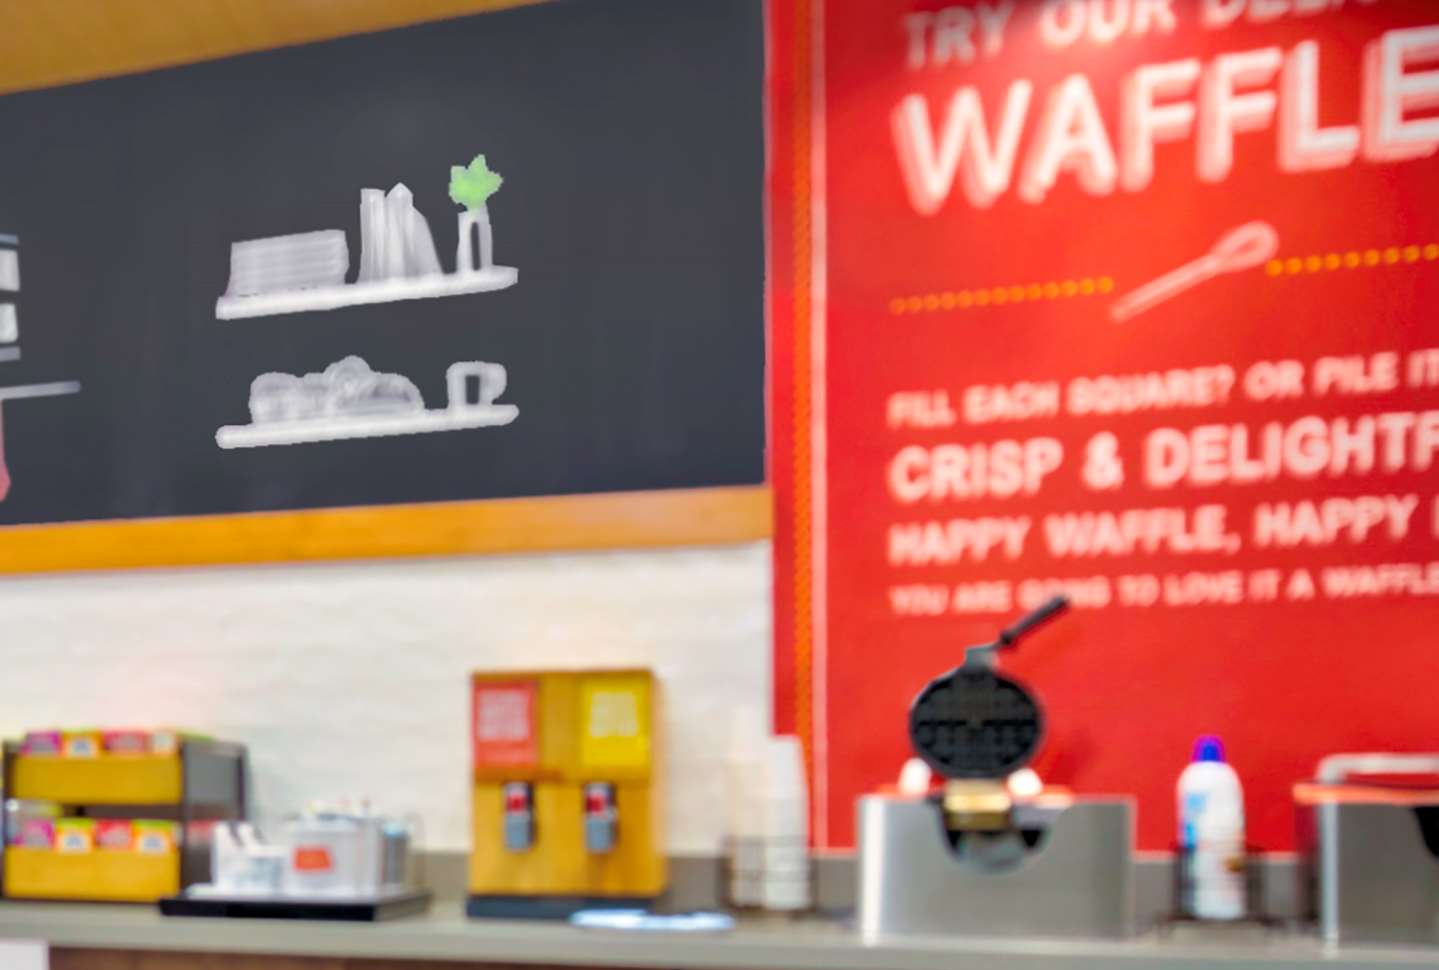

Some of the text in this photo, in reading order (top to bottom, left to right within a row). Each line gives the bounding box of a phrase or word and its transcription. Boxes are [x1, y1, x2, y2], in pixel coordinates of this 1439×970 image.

[904, 0, 1014, 68] TRY
[1040, 0, 1177, 46] OUR
[891, 26, 1439, 214] WAFFLE
[887, 392, 956, 428] FILL
[963, 385, 1059, 424] EACH
[1067, 367, 1234, 415] SQUARE?
[1244, 363, 1305, 401] OR
[1313, 354, 1398, 396] PILE
[888, 439, 1064, 502] CRISP
[1082, 434, 1125, 489] &
[888, 518, 1031, 566] HAPPY
[1043, 507, 1241, 557] WAFFLE,
[1253, 496, 1419, 547] HAPPY
[1118, 576, 1159, 607] TO
[1164, 572, 1243, 605] LOVE
[1286, 570, 1315, 601] A
